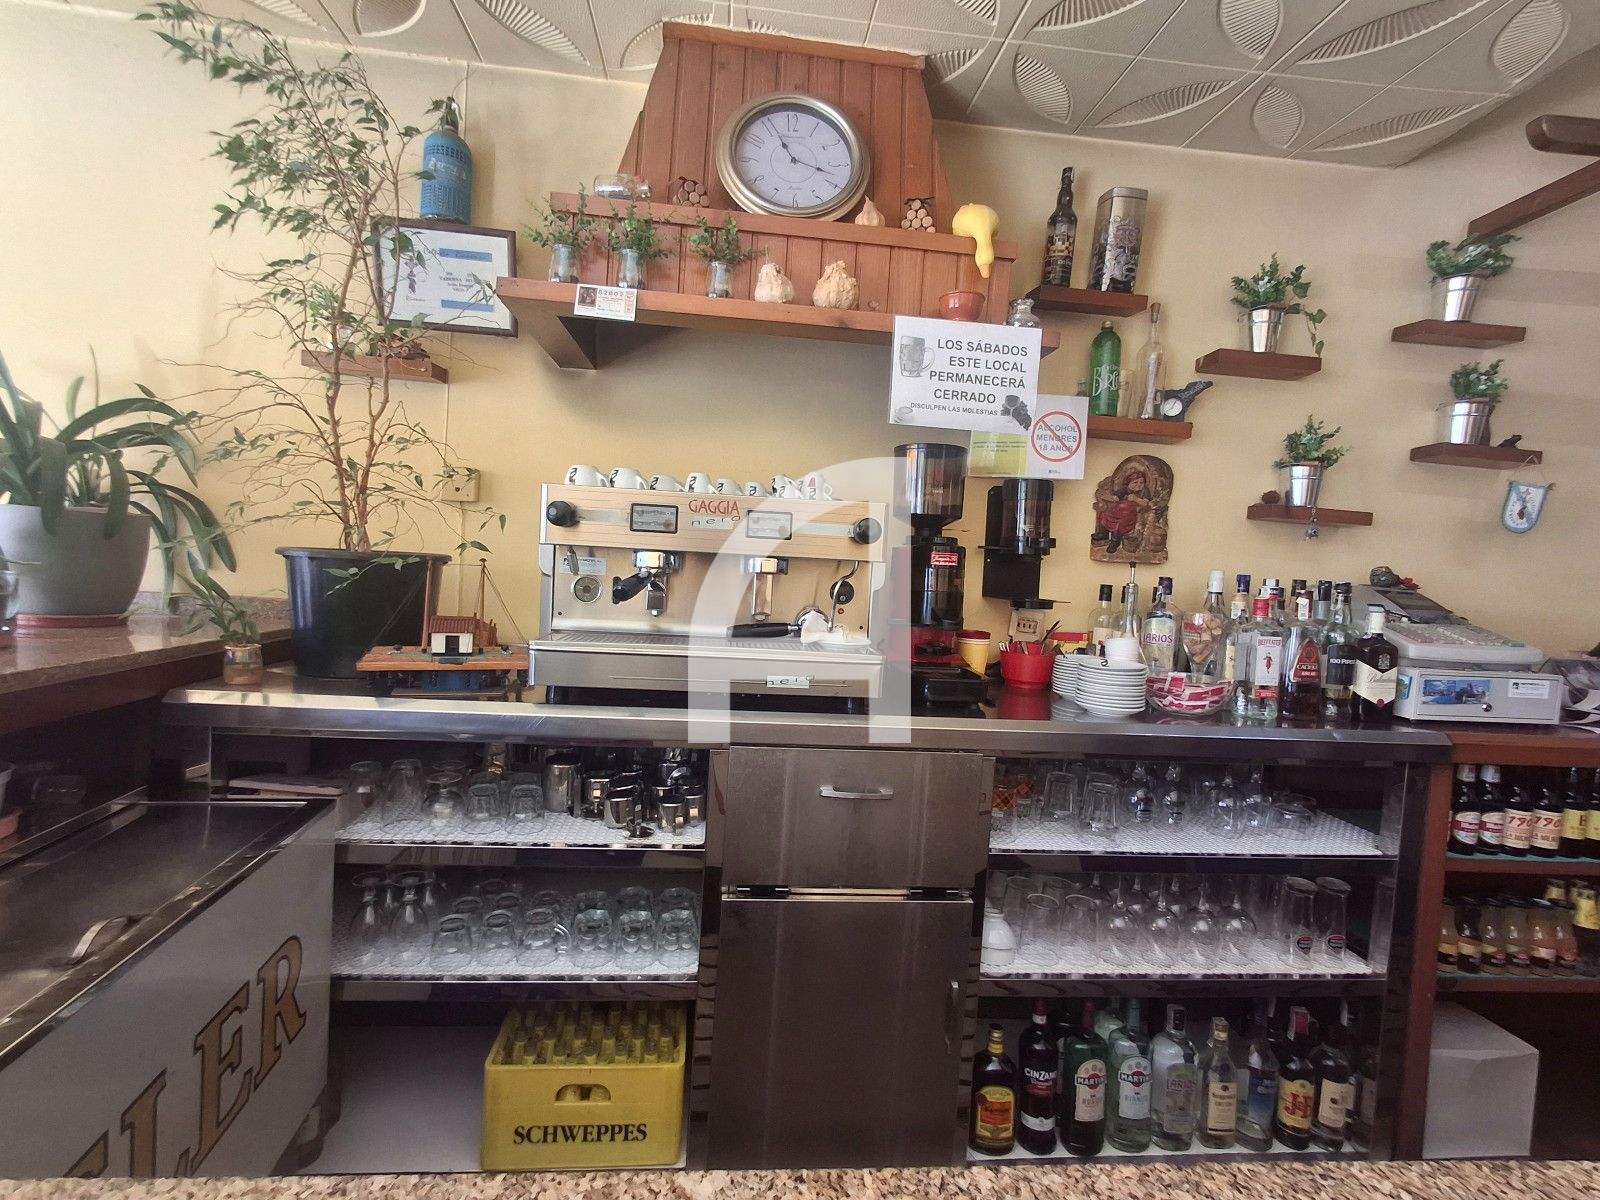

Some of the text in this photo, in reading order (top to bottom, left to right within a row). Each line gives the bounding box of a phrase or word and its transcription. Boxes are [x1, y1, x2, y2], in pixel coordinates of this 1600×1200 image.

[786, 113, 800, 133] 12
[937, 338, 1028, 357] LOS SÁBADOS
[949, 356, 1027, 373] ESTE LOCAL
[929, 370, 1026, 389] PERMANECERÁ
[933, 388, 996, 404] CERRADO
[910, 402, 998, 416] DISCULPEN LAS MOLESTIAS
[1037, 424, 1078, 433] ALCOHOL
[1036, 433, 1078, 443] MENORES
[1039, 444, 1048, 452] 18
[688, 499, 740, 516] GAGGIA
[62, 935, 308, 1178] LER
[513, 1123, 648, 1146] SCHWEPPES
